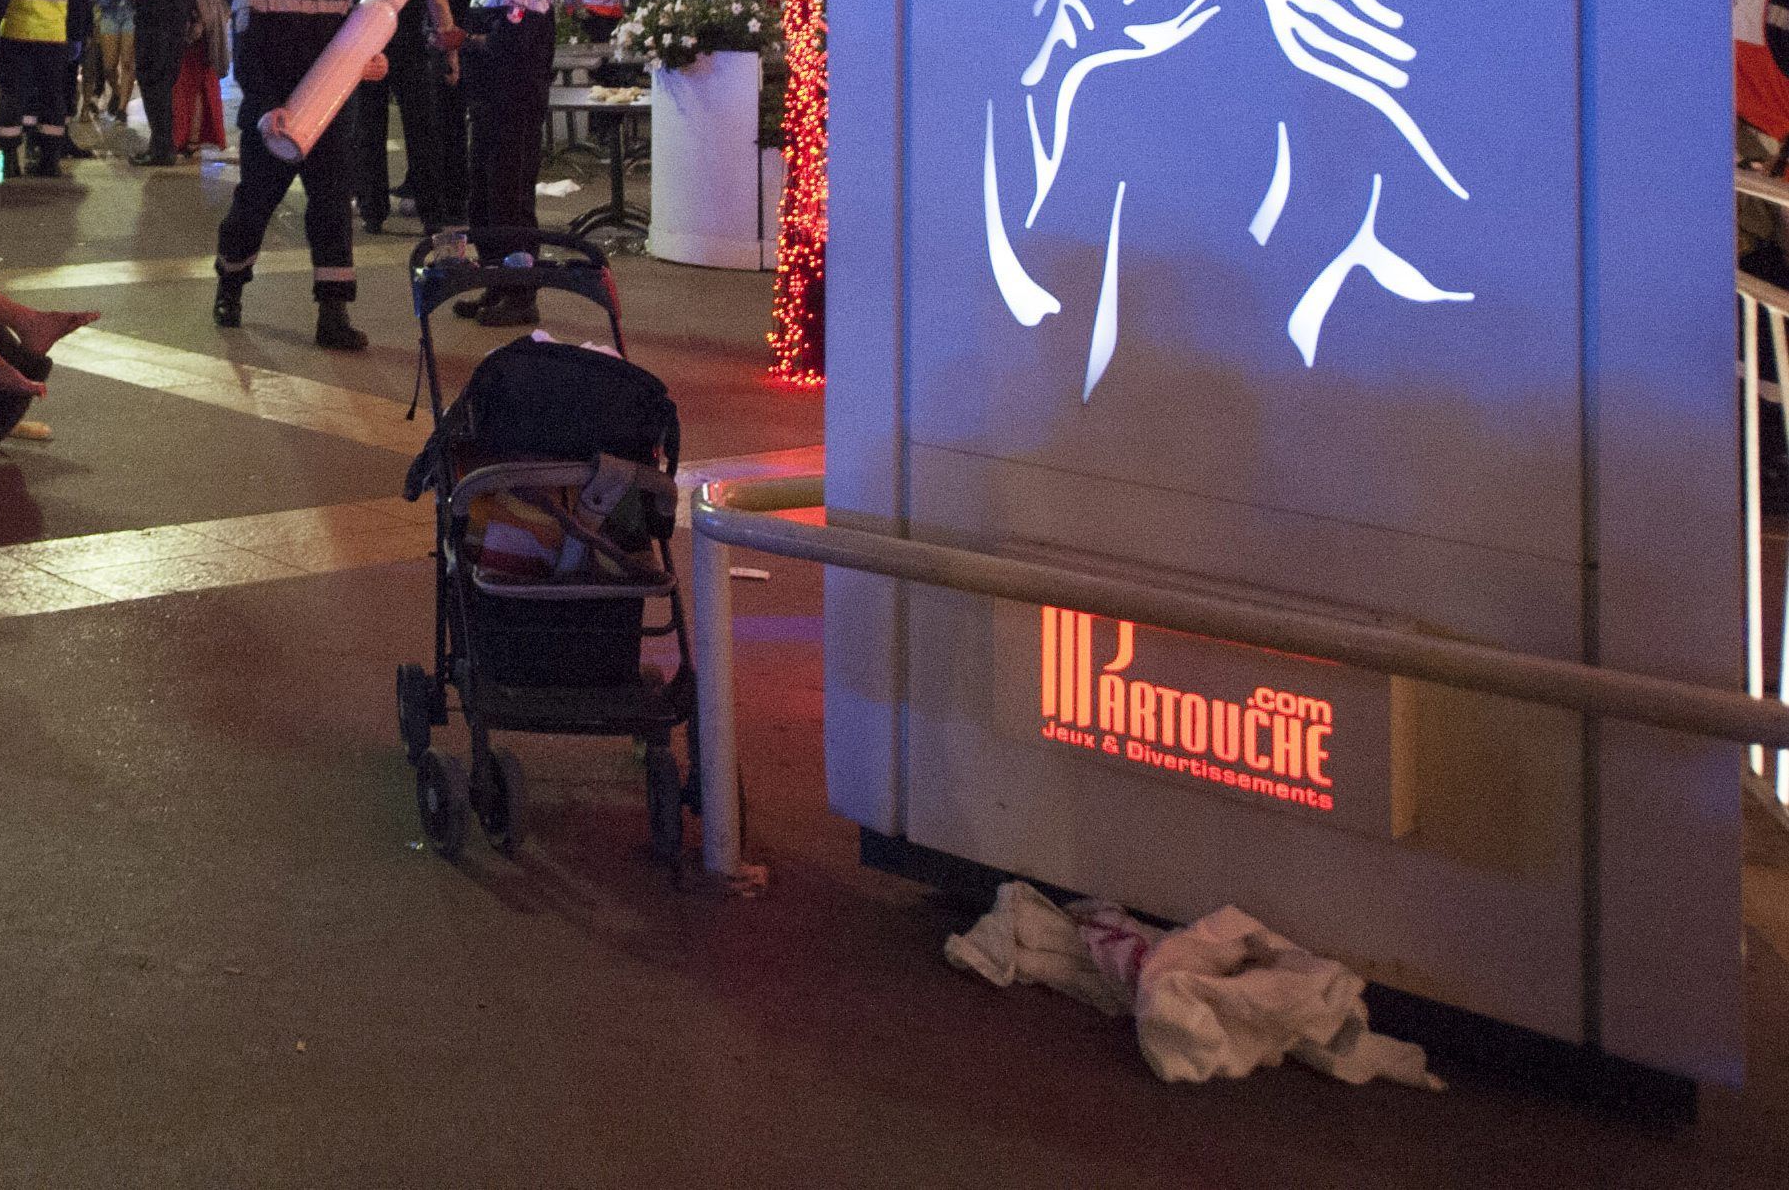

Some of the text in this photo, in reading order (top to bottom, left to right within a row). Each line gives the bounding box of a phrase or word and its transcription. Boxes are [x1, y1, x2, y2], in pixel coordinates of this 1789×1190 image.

[1041, 721, 1333, 811] Jeux & Divertissements
